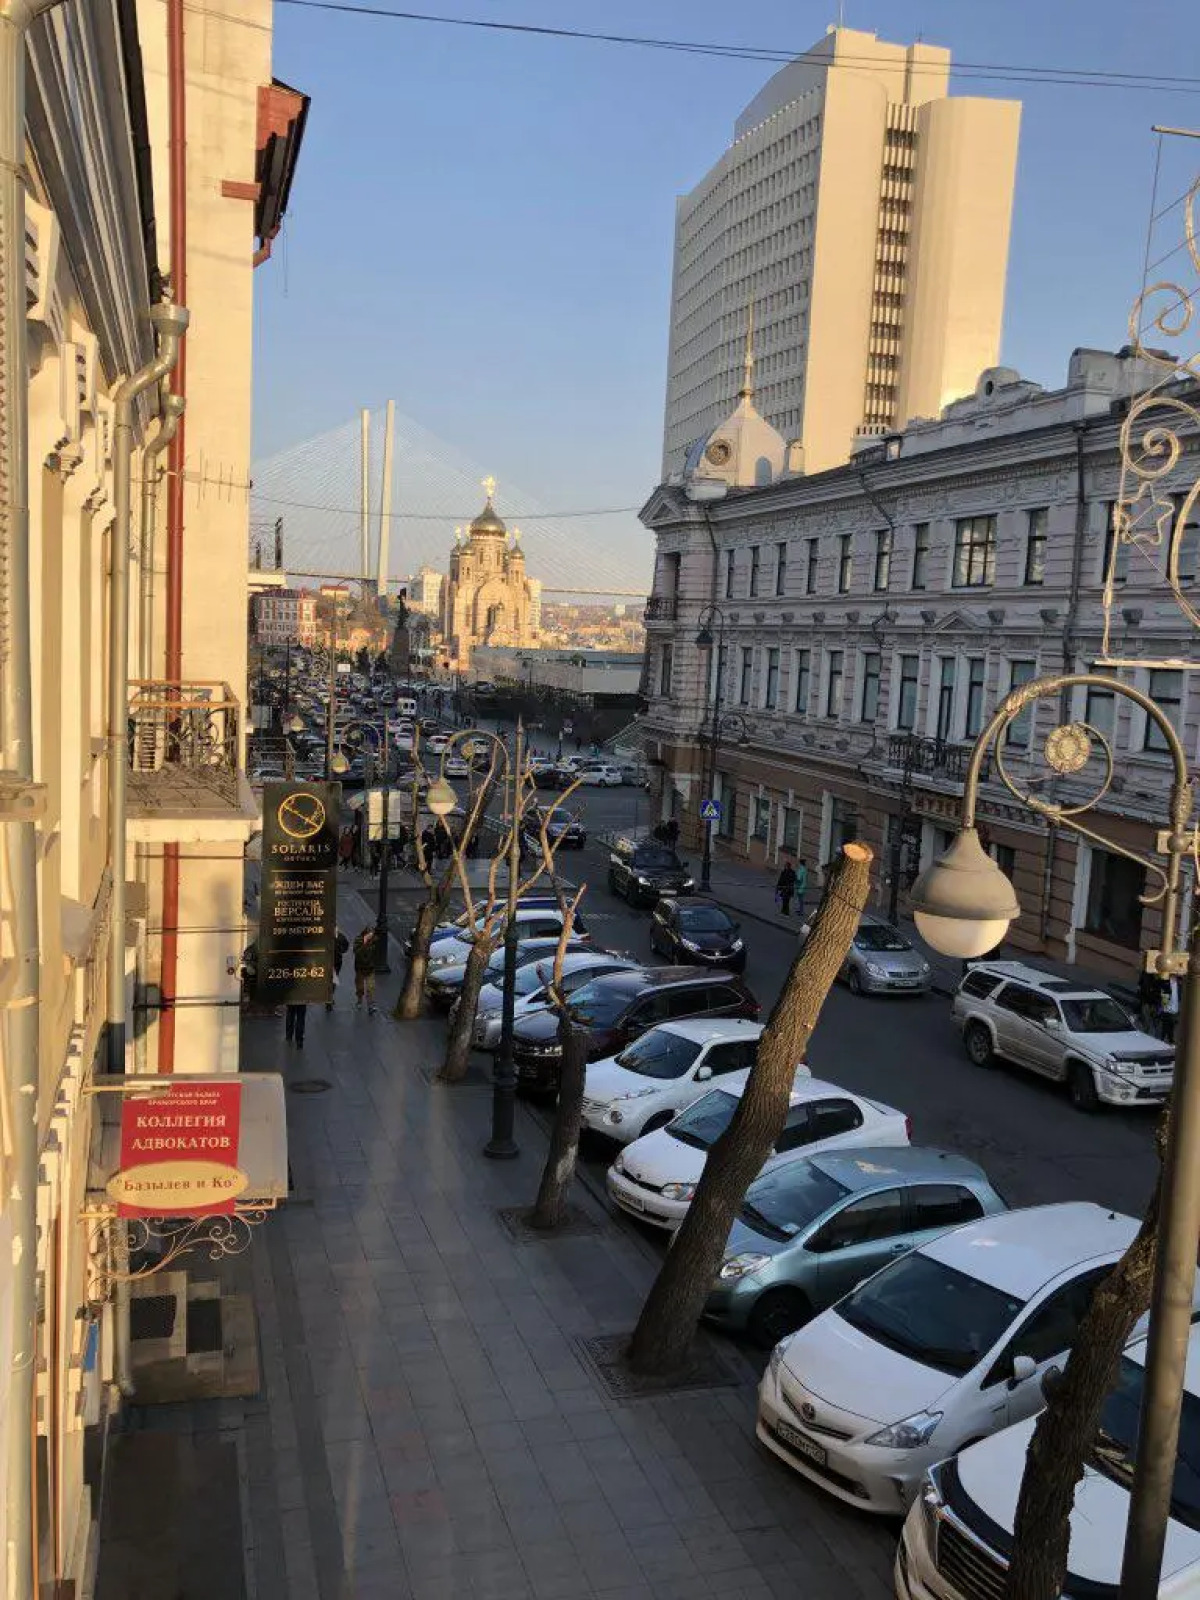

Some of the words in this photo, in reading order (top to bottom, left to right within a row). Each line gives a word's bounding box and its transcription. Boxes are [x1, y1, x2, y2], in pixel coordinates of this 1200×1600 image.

[271, 843, 331, 854] SOLARIS
[274, 906, 325, 917] ВЕРСАЛЬ
[268, 966, 324, 979] 226-62-62
[136, 1115, 226, 1128] КОЛЛЕГИЯ
[131, 1136, 231, 1151] АДВОКАТОВ
[196, 1180, 206, 1188] и
